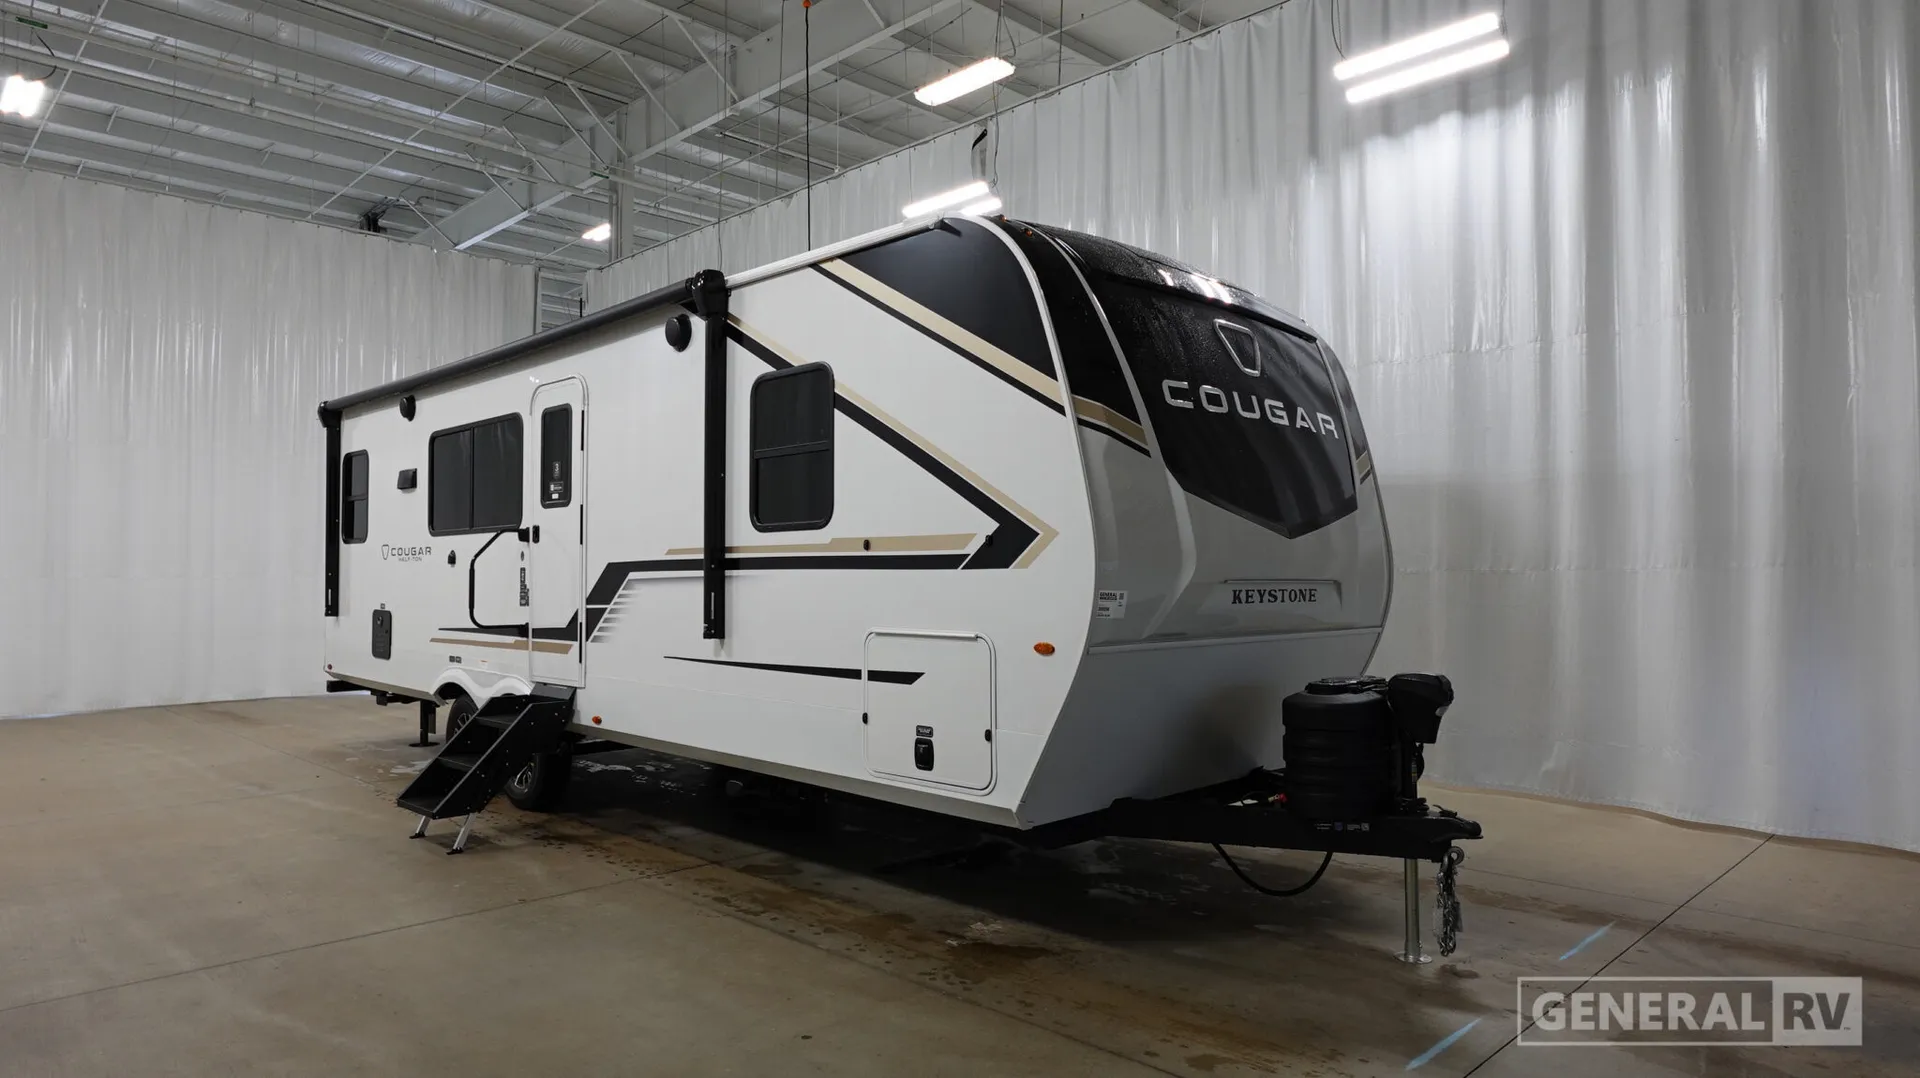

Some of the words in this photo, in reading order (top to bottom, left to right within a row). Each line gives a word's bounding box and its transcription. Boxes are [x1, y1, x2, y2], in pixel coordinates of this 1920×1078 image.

[1161, 379, 1339, 439] COUGAR
[390, 547, 432, 556] COUGAR
[1231, 588, 1318, 605] KEYSTONE
